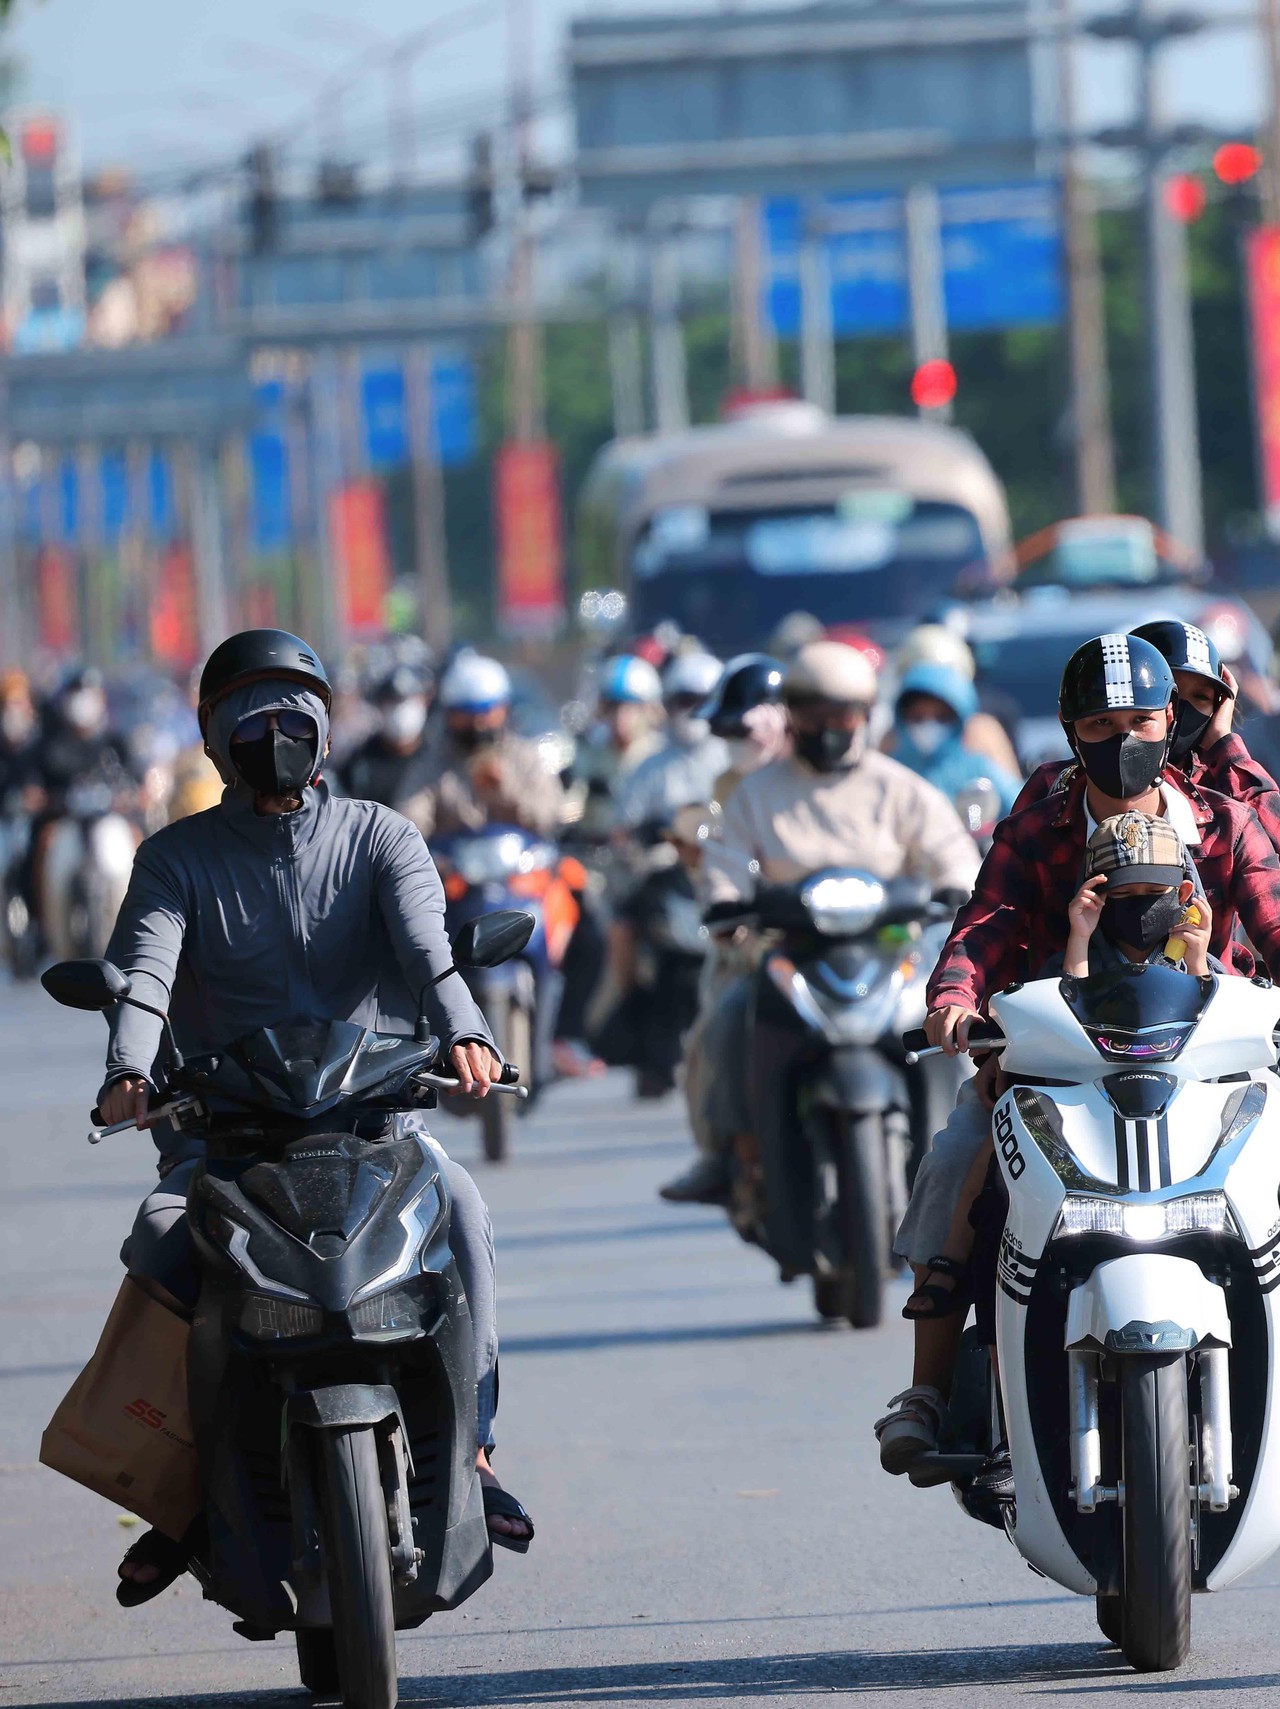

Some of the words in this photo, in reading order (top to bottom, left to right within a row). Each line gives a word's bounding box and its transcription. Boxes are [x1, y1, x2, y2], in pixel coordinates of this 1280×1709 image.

[1119, 1074, 1161, 1083] HONDA
[994, 1101, 1026, 1180] 2000
[291, 1150, 342, 1161] HONDA
